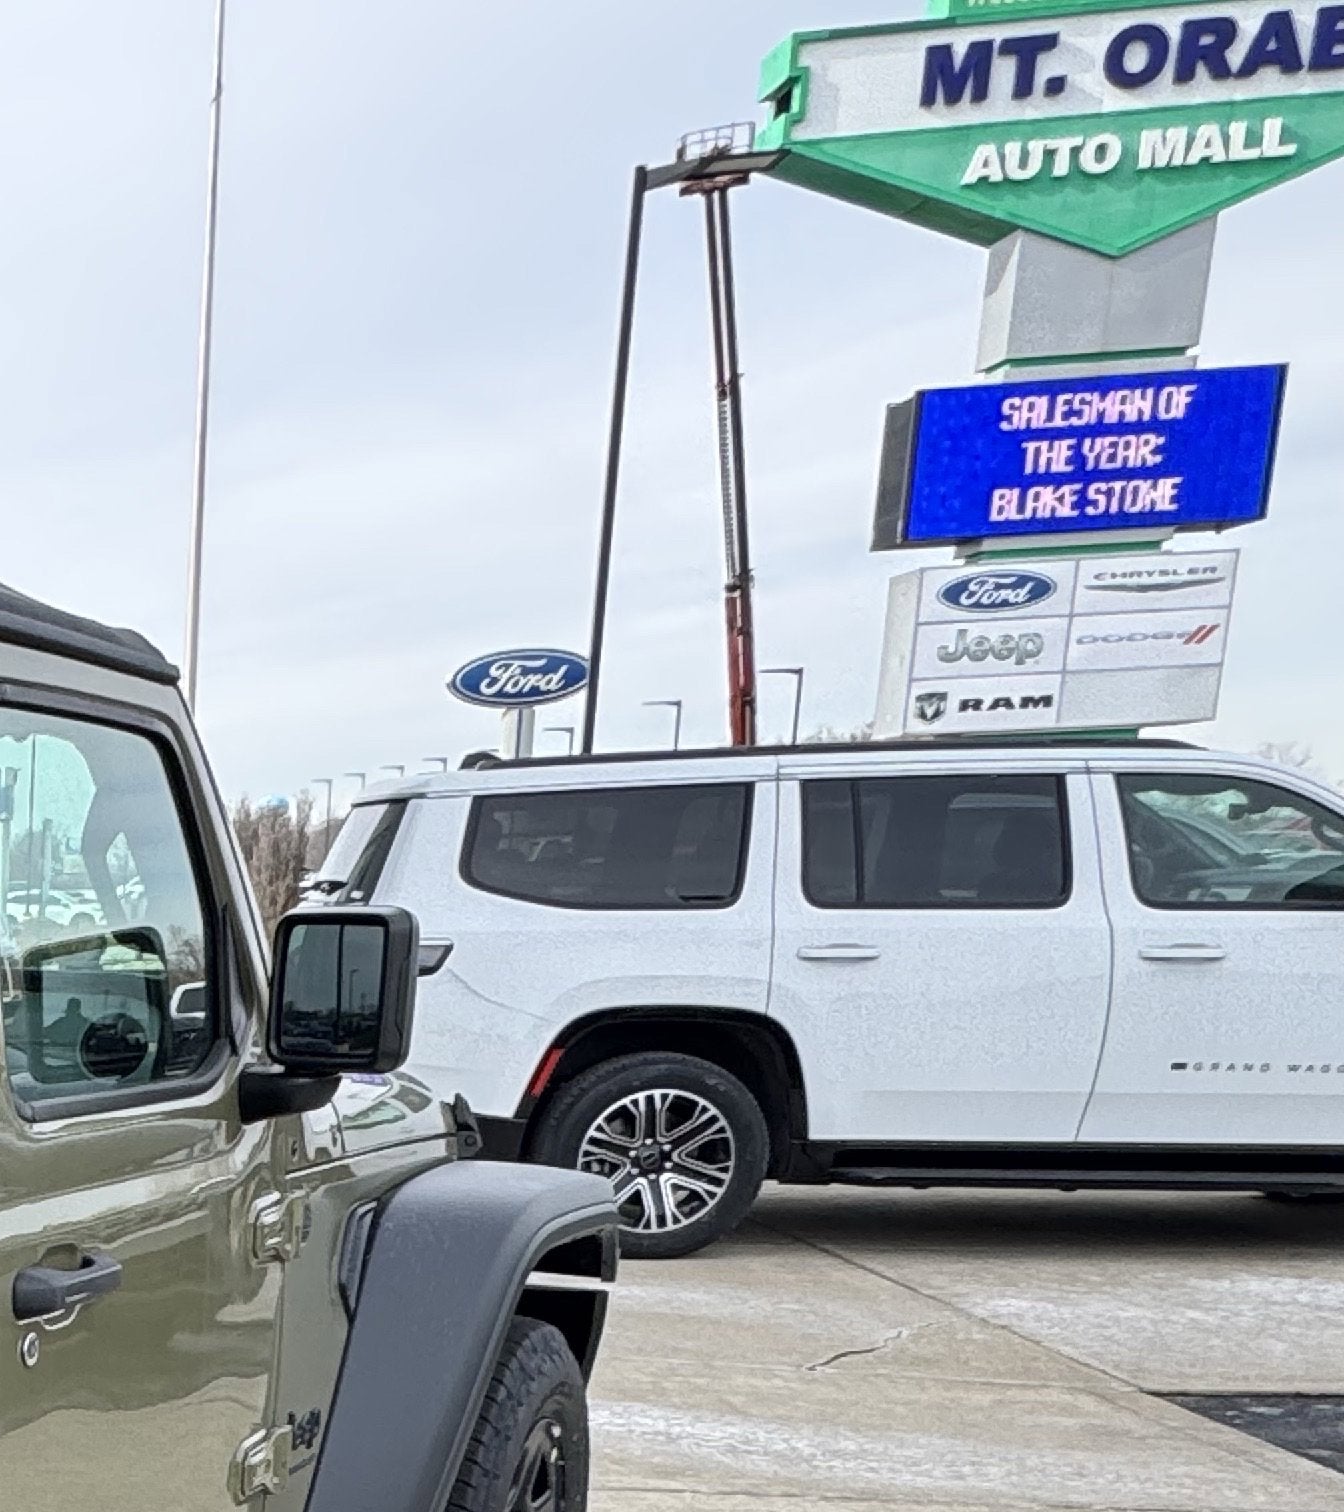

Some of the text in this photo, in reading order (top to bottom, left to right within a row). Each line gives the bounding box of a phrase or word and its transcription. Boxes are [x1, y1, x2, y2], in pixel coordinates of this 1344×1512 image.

[918, 32, 1068, 108] MT.
[960, 117, 1298, 186] AUTO MALL
[999, 384, 1198, 431] SALESMAN OF
[1021, 438, 1078, 475] THE
[989, 482, 1084, 521] BLAKE
[959, 577, 1031, 606] Ford
[1093, 566, 1218, 581] CHRYSLER
[937, 629, 1044, 666] Jeep
[479, 658, 570, 695] Ford
[958, 694, 1054, 713] RAM
